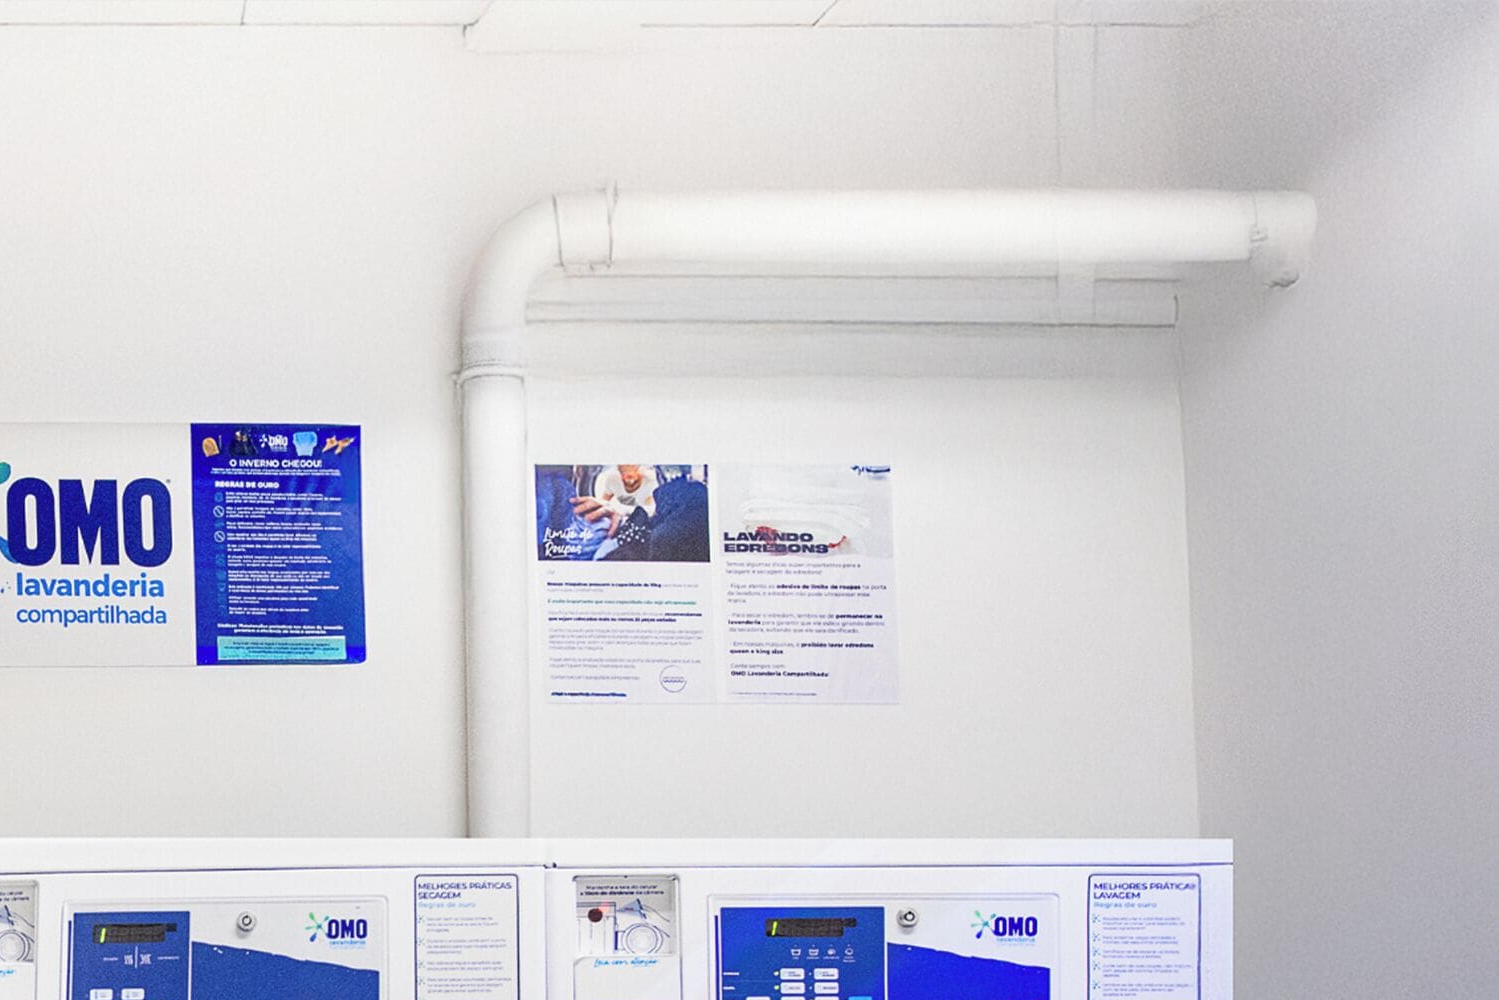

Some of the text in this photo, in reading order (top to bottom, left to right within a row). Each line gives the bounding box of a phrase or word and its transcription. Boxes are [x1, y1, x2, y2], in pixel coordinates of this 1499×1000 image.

[282, 459, 322, 468] CHEGOU!
[6, 477, 172, 568] OMO
[724, 532, 814, 542] LAVANDO
[724, 544, 829, 553] EDREDONS
[16, 573, 165, 598] lavanderia
[16, 605, 167, 628] compartilhada
[469, 881, 512, 890] PRÁTICAS
[1094, 883, 1148, 891] MELHORES
[418, 892, 461, 900] SECAGEM
[1094, 892, 1141, 900] LAVAGEM
[327, 919, 367, 939] OMO
[993, 916, 1038, 937] OMO
